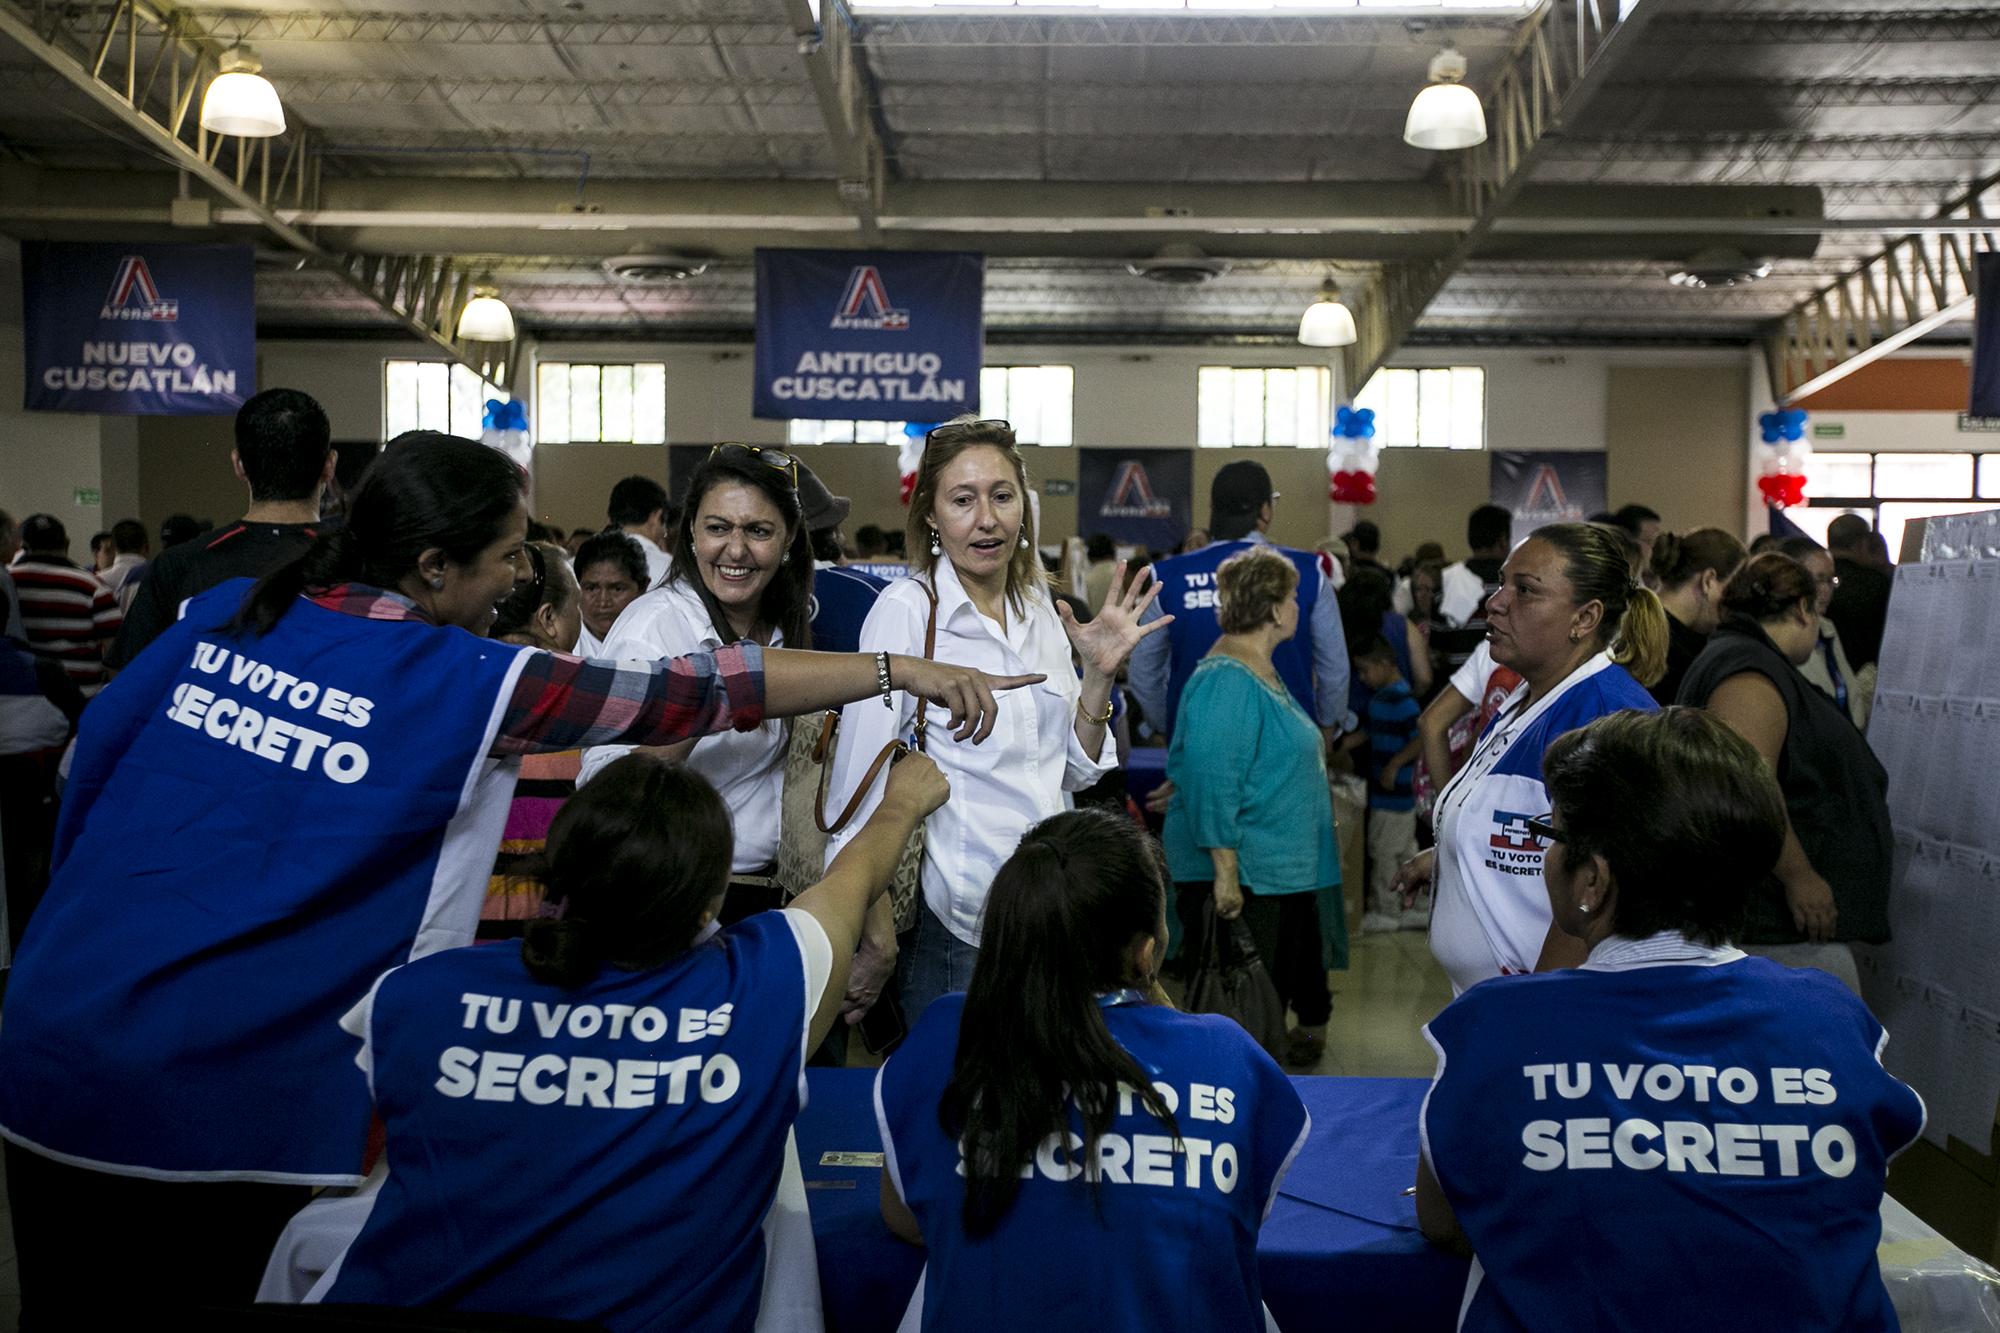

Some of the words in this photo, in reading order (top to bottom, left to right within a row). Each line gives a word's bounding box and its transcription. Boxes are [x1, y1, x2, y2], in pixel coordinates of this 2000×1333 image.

[83, 341, 195, 366] NUEVO
[797, 351, 941, 375] ANTIGUO
[44, 364, 236, 394] CUSCATLÁN
[772, 374, 965, 401] CUSCATLÁN
[871, 565, 906, 577] VOTO
[1184, 572, 1209, 588] TU
[190, 641, 230, 674] TU
[228, 654, 320, 710] VOTO
[317, 687, 376, 728] ES
[166, 682, 370, 784] SECRETO
[1485, 859, 1498, 869] ES
[1498, 863, 1544, 876] SECRET
[1491, 849, 1506, 860] TU
[1508, 852, 1542, 863] VOTO
[461, 992, 522, 1034] TU
[531, 1002, 668, 1043] VOTO
[677, 1002, 734, 1043] ES
[434, 1046, 741, 1109] SECRETO
[1523, 1062, 1592, 1100] TU
[1602, 1063, 1759, 1104] VOTO
[1770, 1067, 1838, 1104] ES
[1190, 1082, 1236, 1124] ES
[1521, 1117, 1857, 1179] SECRETO
